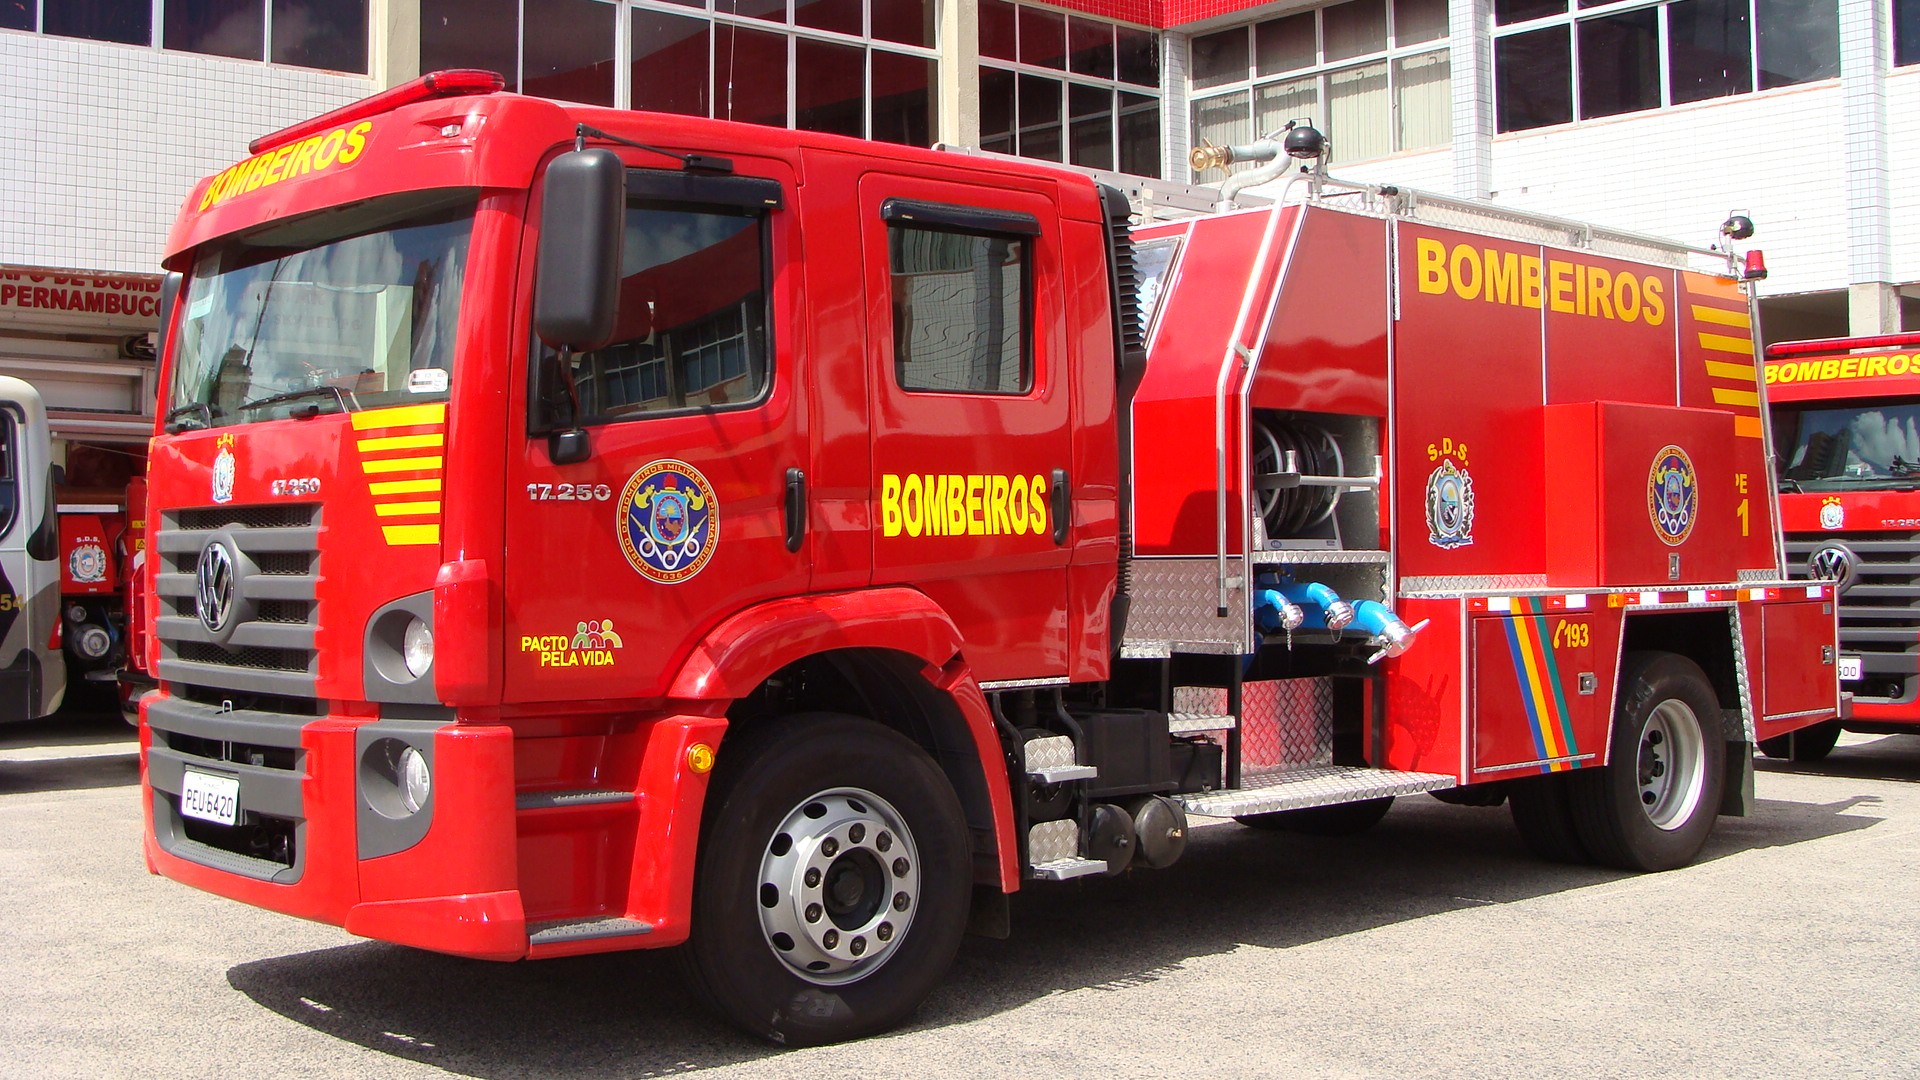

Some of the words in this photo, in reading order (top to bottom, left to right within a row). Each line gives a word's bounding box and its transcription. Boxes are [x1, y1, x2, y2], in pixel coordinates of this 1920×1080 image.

[197, 121, 372, 213] BOMBEIROS
[1416, 237, 1665, 327] BOMBEIROS
[1764, 353, 1920, 385] BOMBEIROS
[526, 483, 612, 502] 17.250
[621, 464, 665, 513] BOMBEIROS
[667, 463, 701, 485] MILITAR
[881, 473, 1047, 537] BOMBEIROS
[1737, 498, 1749, 537] 1
[521, 635, 569, 652] PACTO
[1564, 623, 1590, 648] 193
[541, 651, 579, 667] PELA
[581, 650, 615, 666] VIDA
